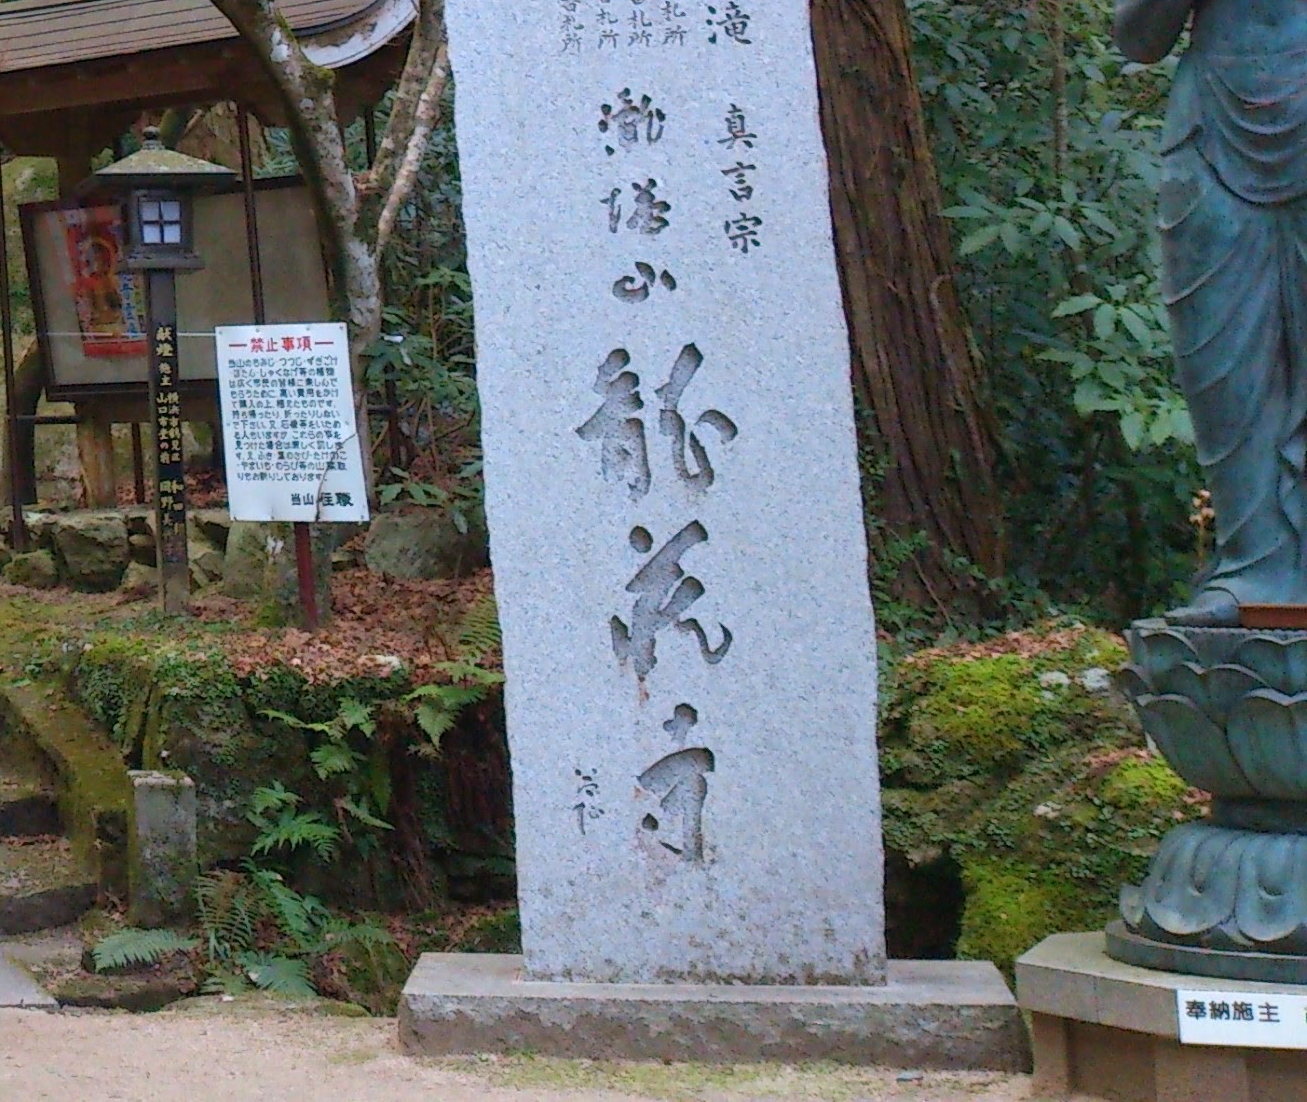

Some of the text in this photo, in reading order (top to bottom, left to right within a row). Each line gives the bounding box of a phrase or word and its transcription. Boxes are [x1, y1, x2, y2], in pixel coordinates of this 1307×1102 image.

[717, 103, 763, 255] 真言宗
[250, 336, 313, 353] 禁止事項
[1185, 999, 1281, 1023] 奉納施主
